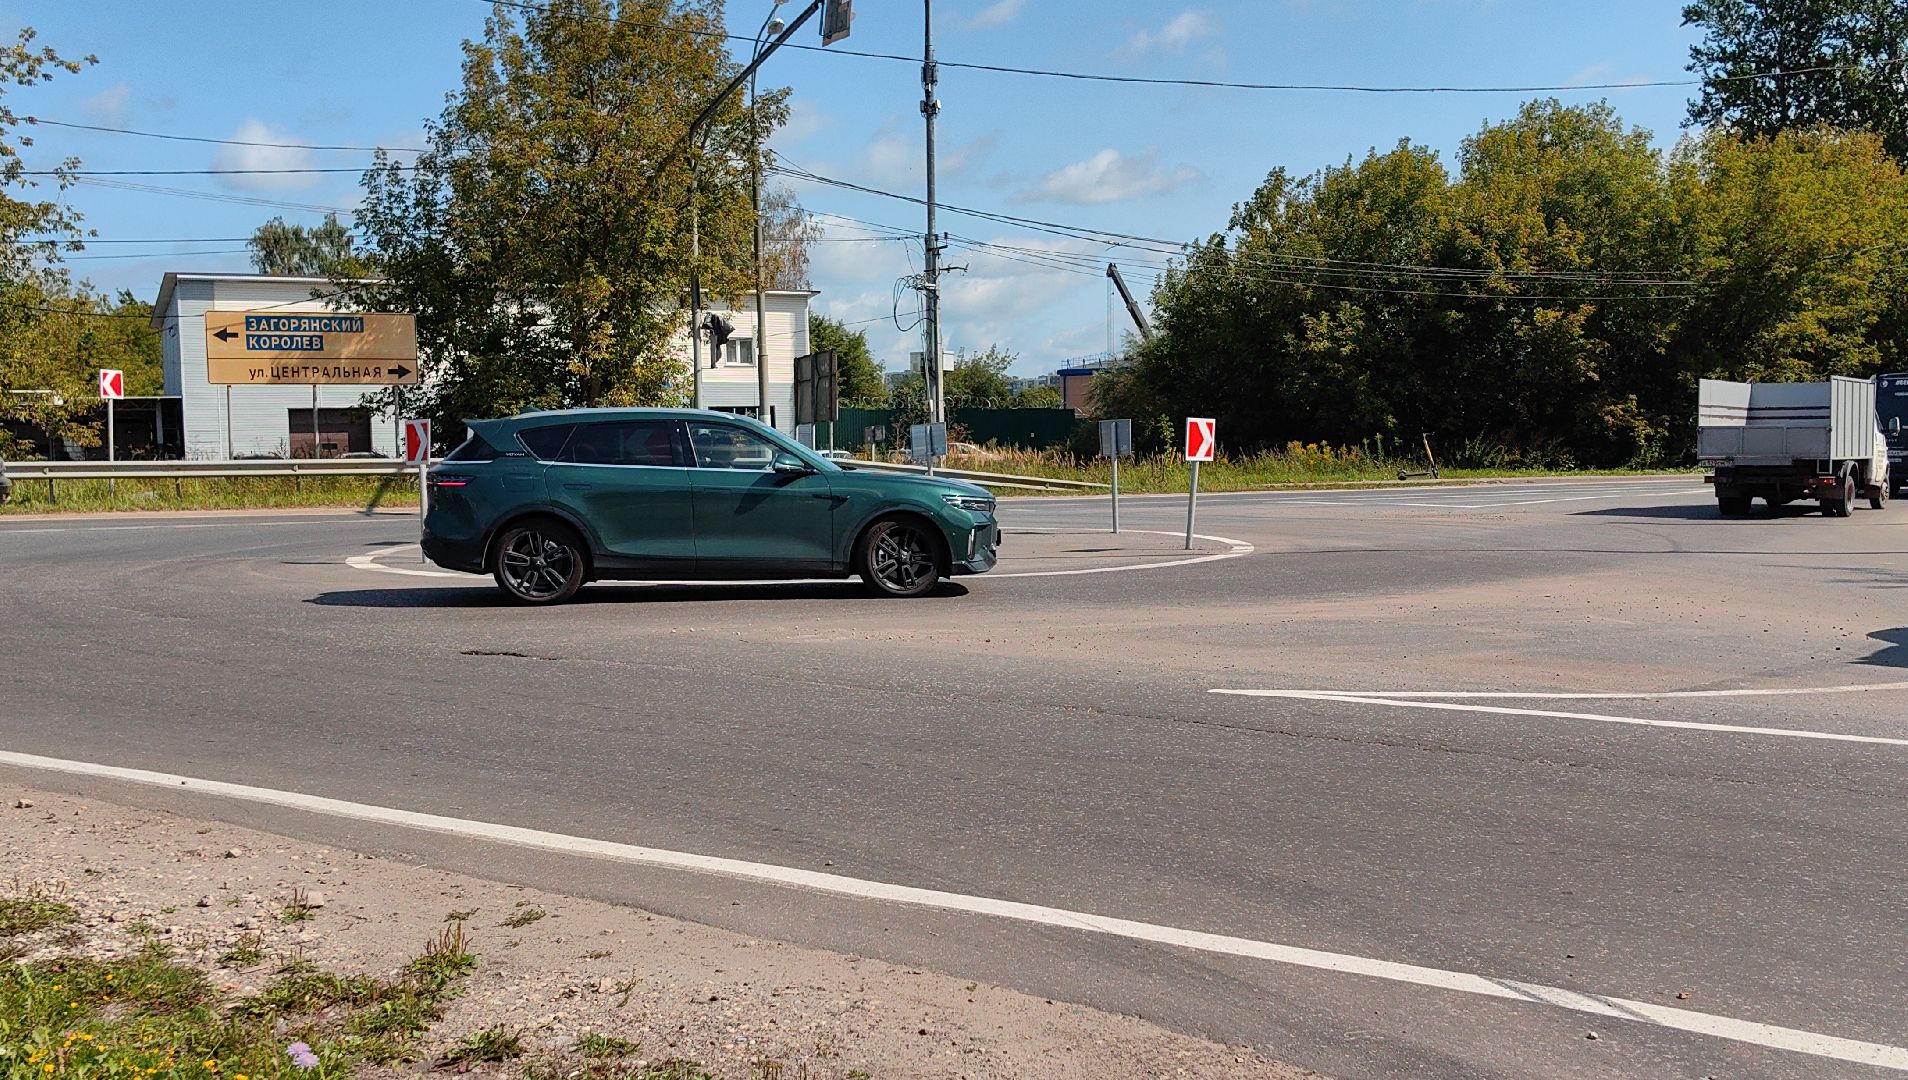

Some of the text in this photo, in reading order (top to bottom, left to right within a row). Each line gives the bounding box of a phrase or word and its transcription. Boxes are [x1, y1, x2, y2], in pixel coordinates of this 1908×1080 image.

[248, 317, 361, 332] ЗАГОРЯНСКИЙ
[249, 336, 321, 349] КОРОЛЕВ
[249, 366, 382, 380] ул. ЦЕНТРАЛЬНАЯ
